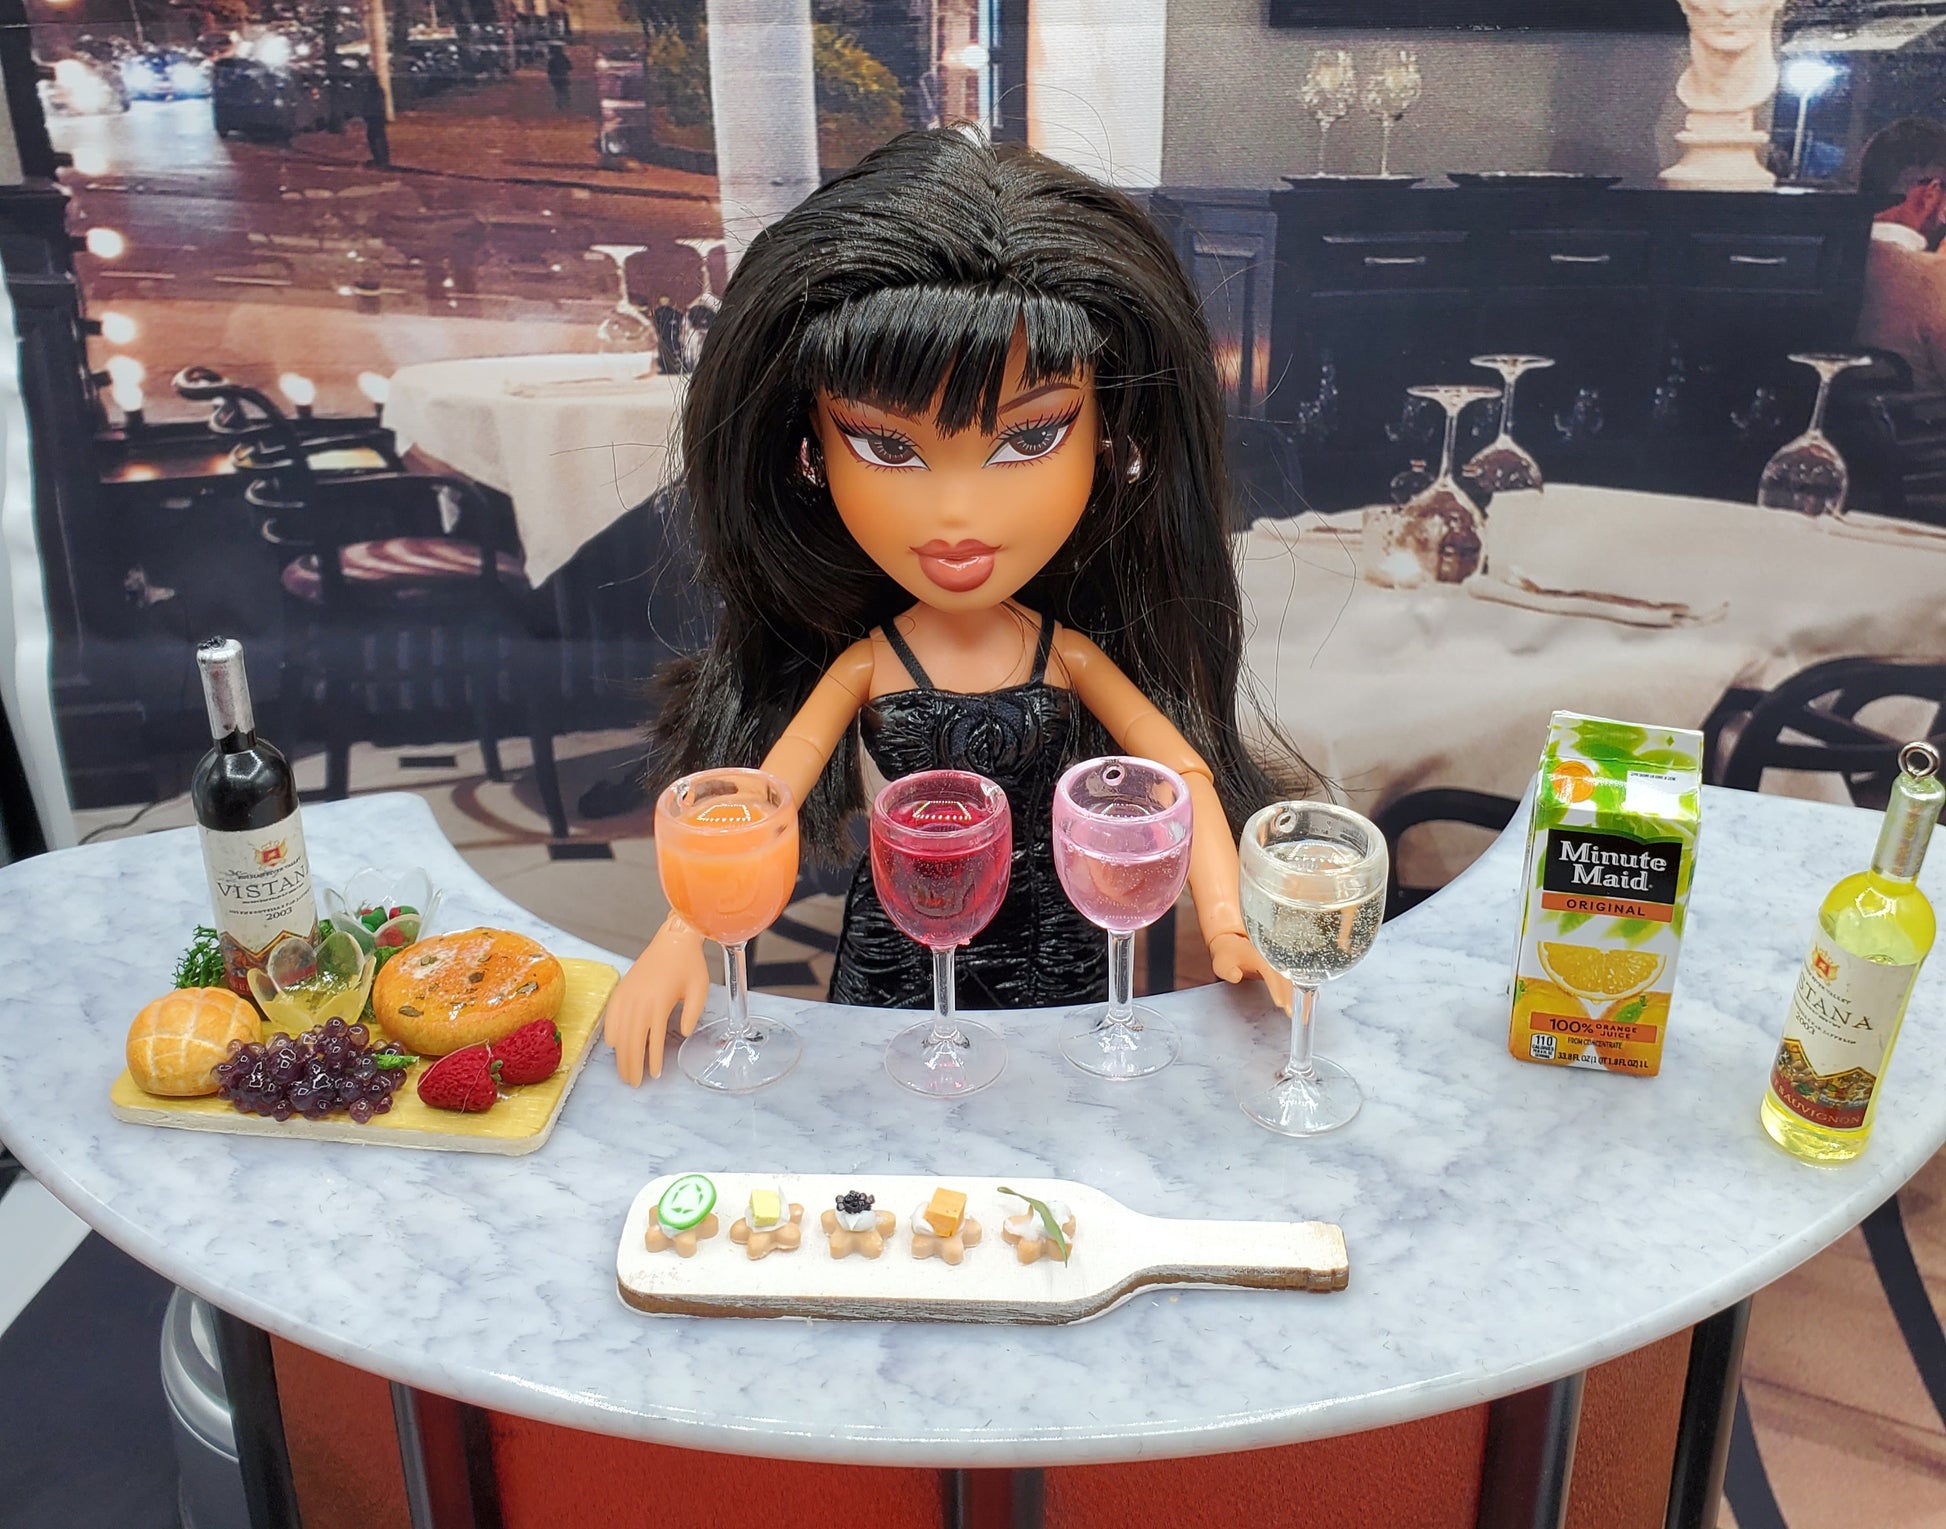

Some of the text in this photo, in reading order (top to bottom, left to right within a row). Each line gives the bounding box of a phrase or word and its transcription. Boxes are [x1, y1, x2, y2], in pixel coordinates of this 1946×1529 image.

[1559, 840, 1667, 872] Minute
[217, 865, 309, 899] VISTAN
[1571, 863, 1650, 892] Maid
[265, 906, 293, 920] 2003
[1566, 899, 1646, 916] ORIGINAL
[1549, 1018, 1638, 1034] 100% ORANGE
[1795, 1011, 1816, 1035] 2003
[1535, 1034, 1554, 1047] 110
[1567, 1036, 1623, 1050] FROM CONCENTRATE
[1600, 1030, 1631, 1039] JUICE
[1778, 1085, 1860, 1124] SAUVIGNON
